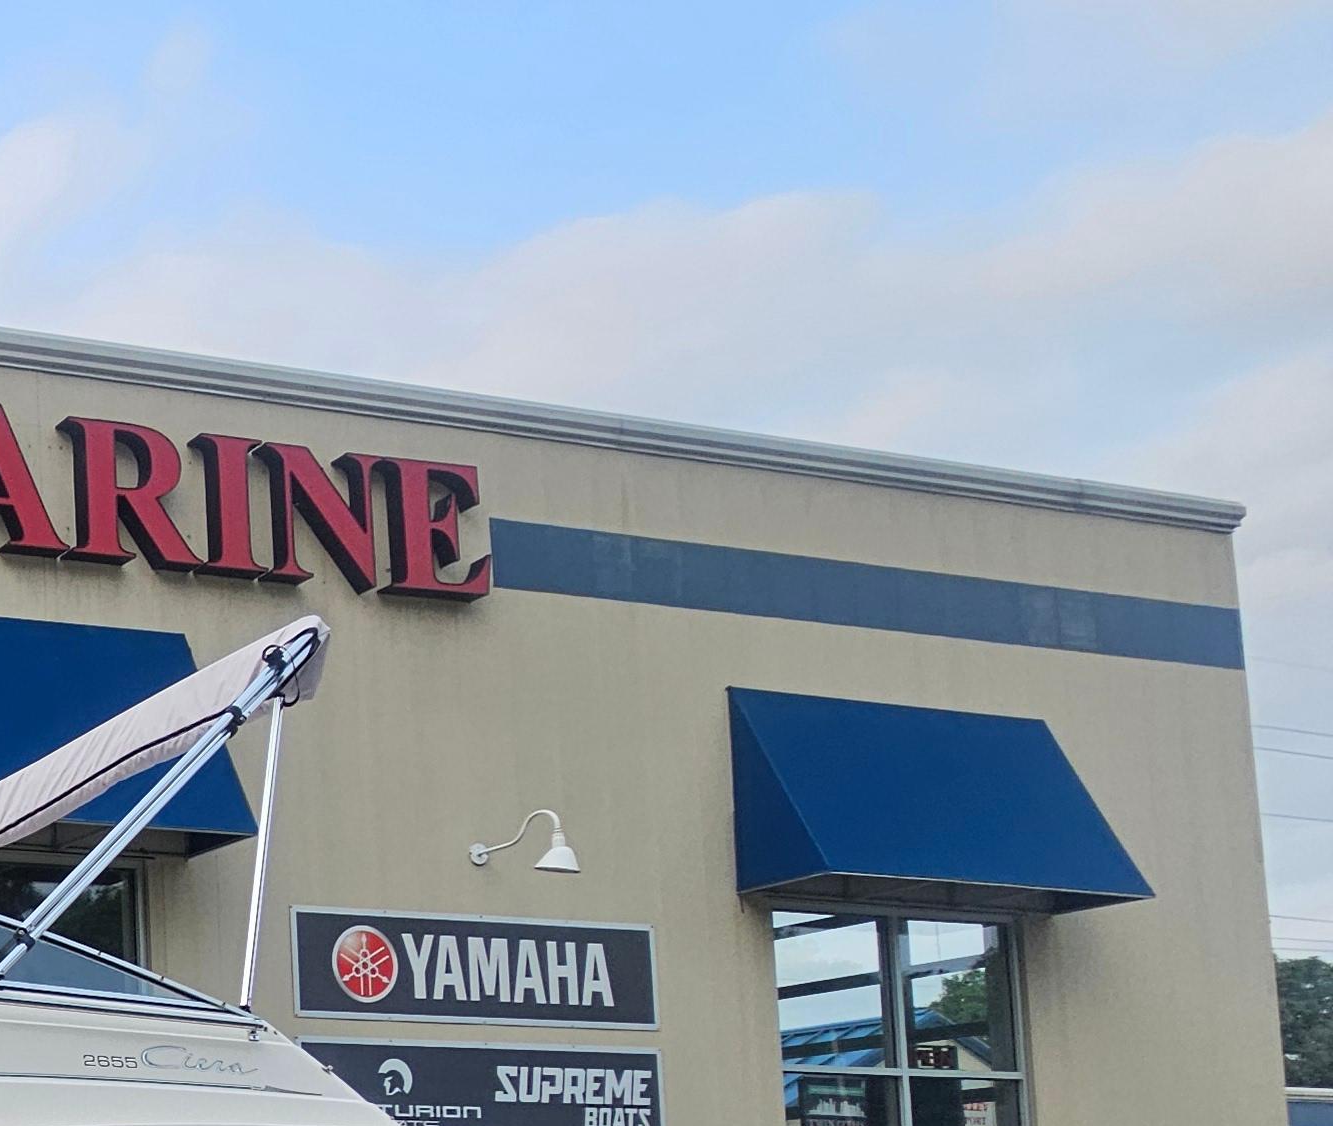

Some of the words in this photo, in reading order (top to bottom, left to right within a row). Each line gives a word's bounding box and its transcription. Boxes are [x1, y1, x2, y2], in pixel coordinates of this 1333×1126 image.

[401, 933, 614, 1007] YAMAHA
[83, 1054, 138, 1069] 2655
[494, 1065, 652, 1106] SUPREME
[379, 1103, 481, 1119] TURION
